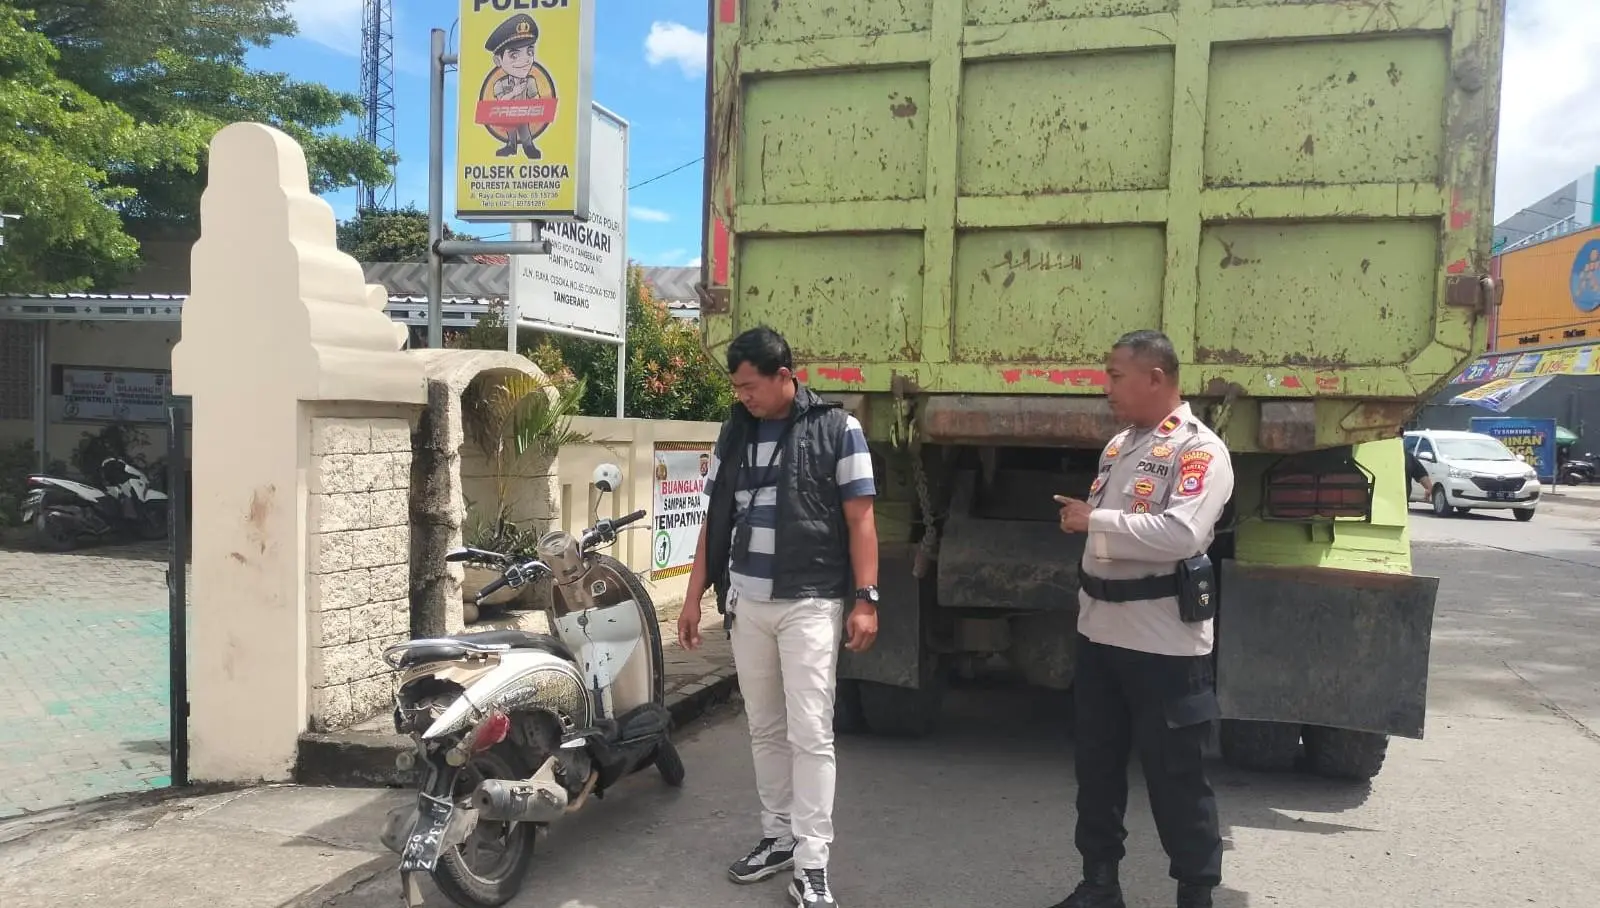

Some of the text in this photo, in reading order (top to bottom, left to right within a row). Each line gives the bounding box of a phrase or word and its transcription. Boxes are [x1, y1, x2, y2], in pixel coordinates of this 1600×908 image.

[464, 165, 569, 179] POLSEK CISOKA
[470, 181, 561, 189] POLRESTA TANGERANG
[548, 253, 595, 275] RANTING CISOKA
[535, 270, 549, 283] RAYA
[584, 284, 602, 296] CISOKA
[553, 290, 590, 309] TANGERANG
[1136, 460, 1169, 476] POLRI
[661, 480, 704, 495] BUANGLAH
[663, 496, 687, 511] SAMPAH
[655, 510, 708, 530] TEMPATNYA
